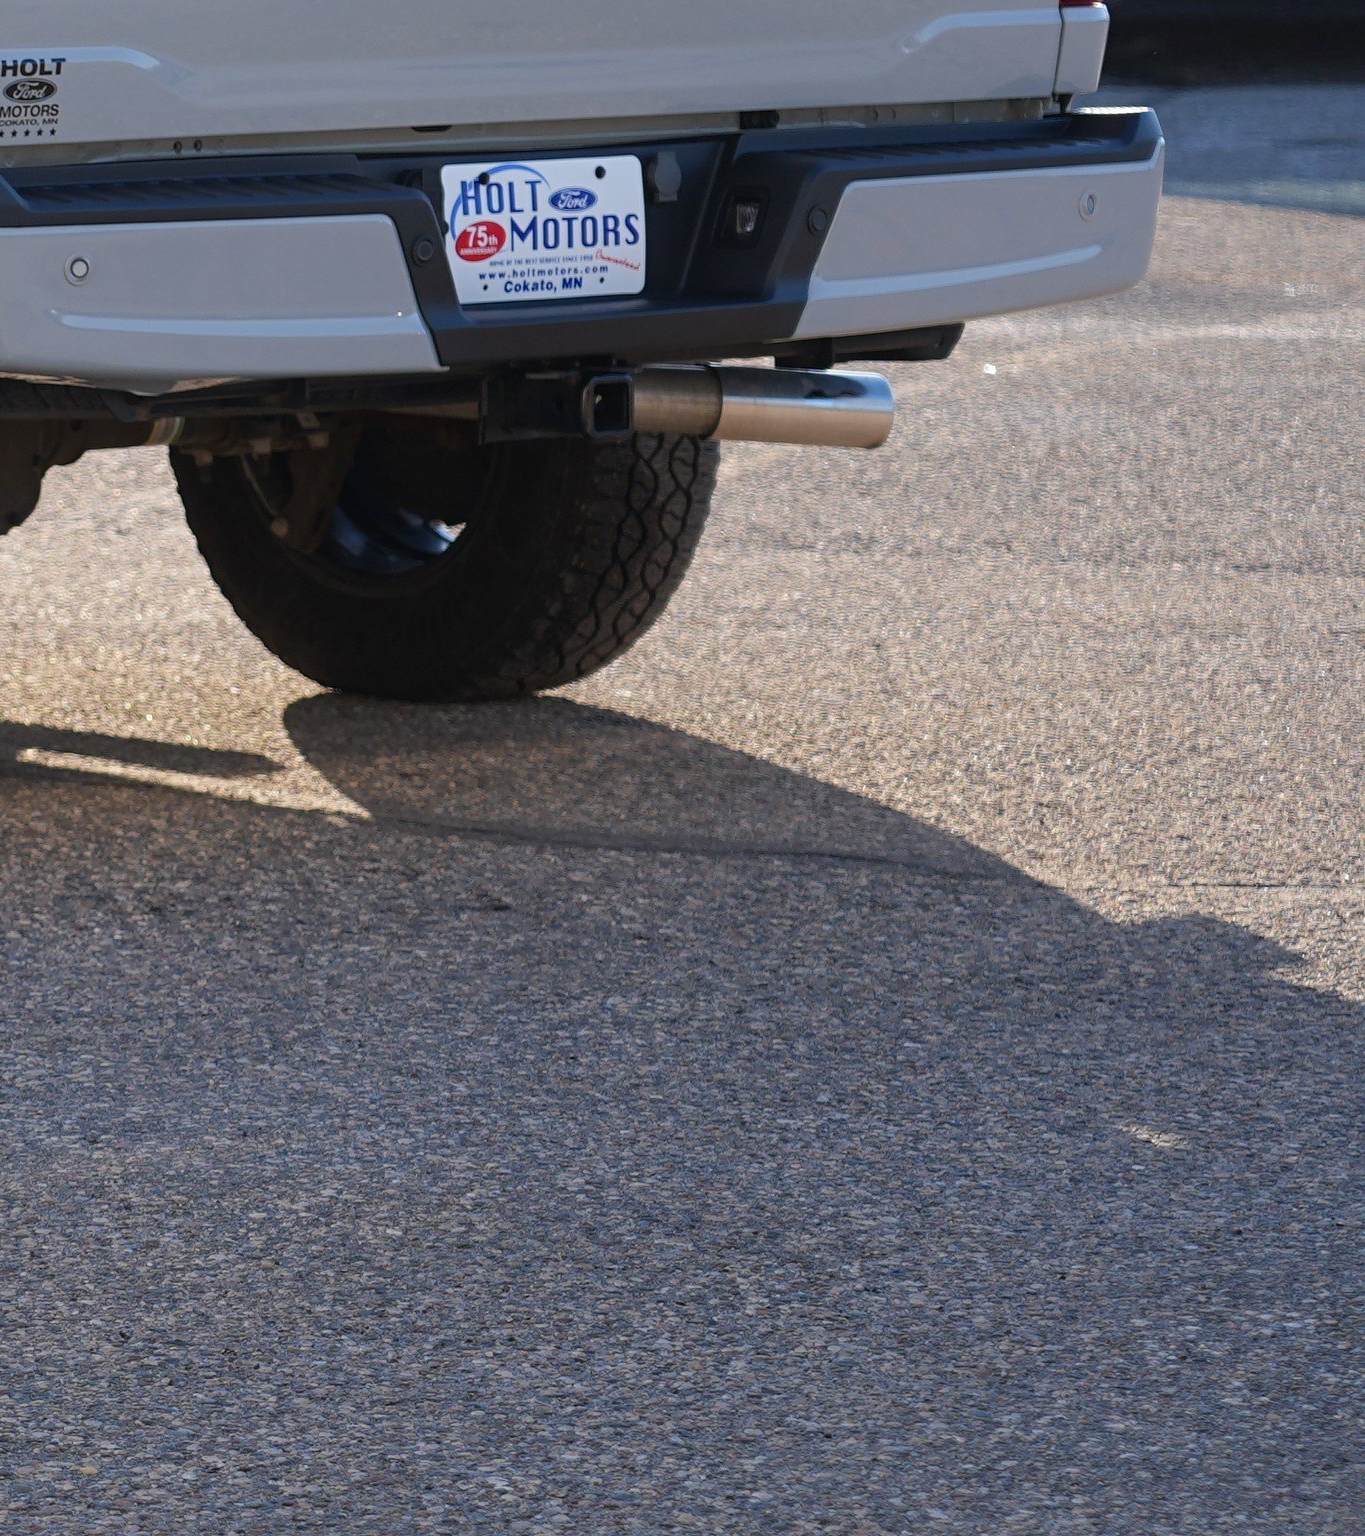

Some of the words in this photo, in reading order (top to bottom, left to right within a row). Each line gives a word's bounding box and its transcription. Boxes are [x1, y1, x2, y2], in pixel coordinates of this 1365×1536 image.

[0, 57, 67, 77] HOLT
[12, 81, 48, 100] Ford
[42, 117, 59, 125] MN
[460, 178, 542, 216] HOLT
[510, 213, 641, 252] MOTORS
[478, 265, 609, 280] www.holtmotors.com
[503, 280, 557, 293] Cokato,
[562, 277, 583, 289] MN
